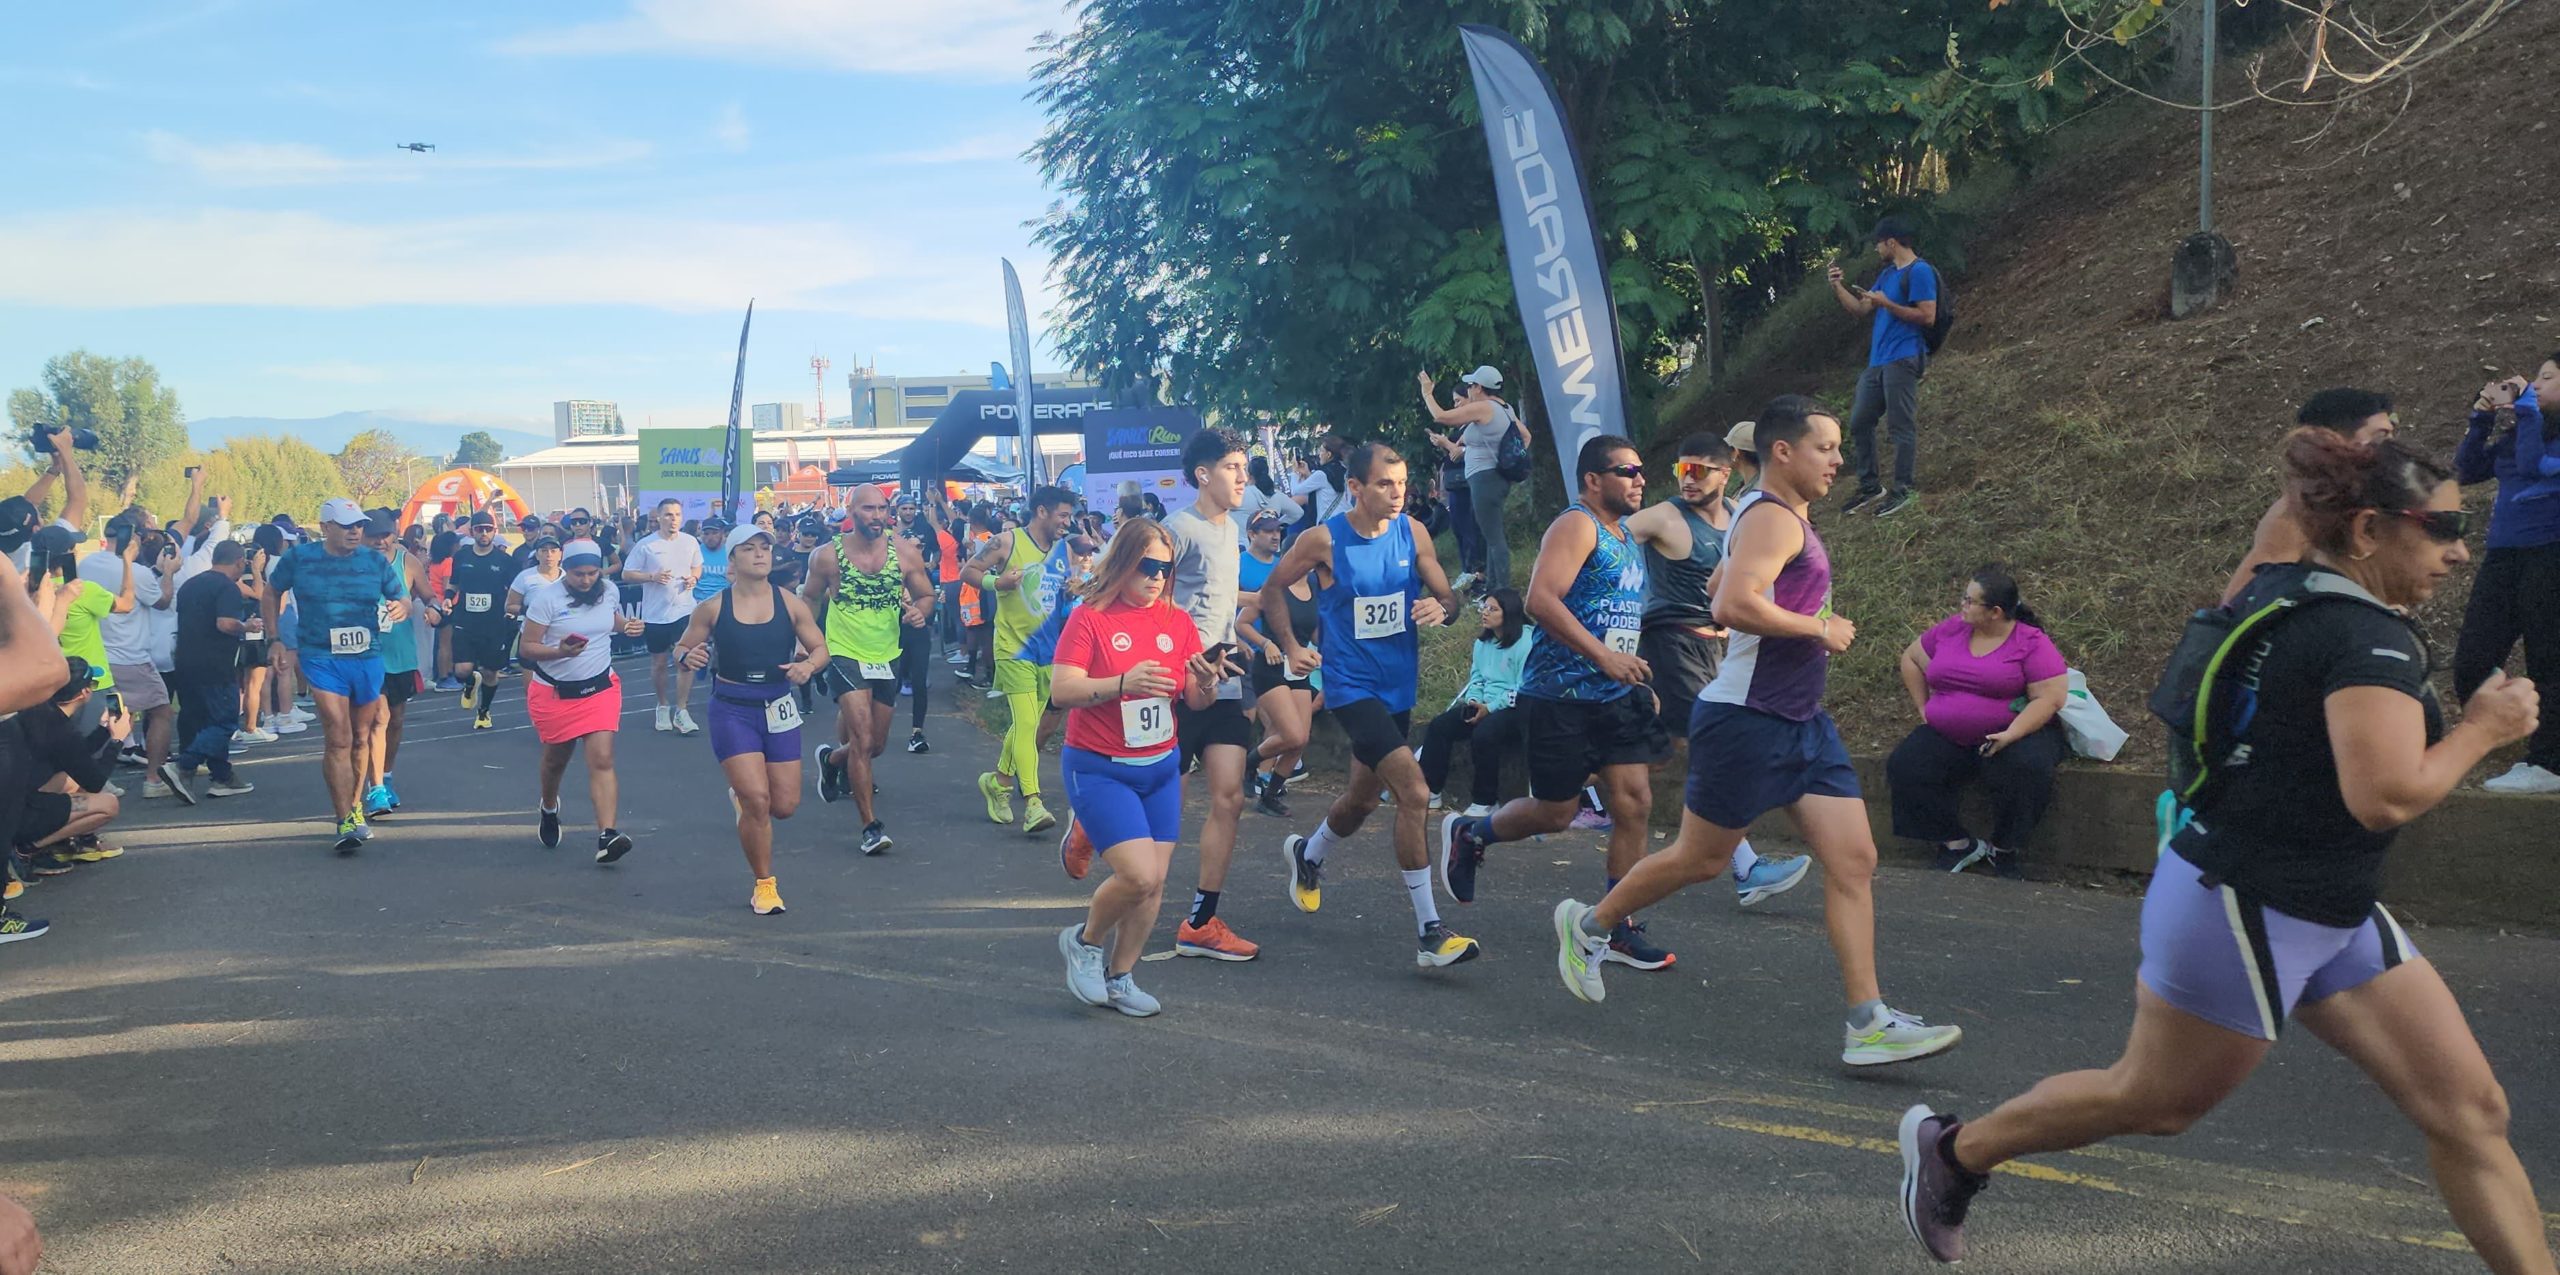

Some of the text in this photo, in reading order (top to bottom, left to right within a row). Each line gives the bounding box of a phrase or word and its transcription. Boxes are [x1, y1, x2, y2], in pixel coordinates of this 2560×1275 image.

[438, 476, 464, 496] G
[469, 597, 487, 607] 526
[1364, 601, 1397, 625] 326
[340, 631, 364, 647] 610
[778, 702, 794, 721] 82
[1140, 705, 1160, 731] 97
